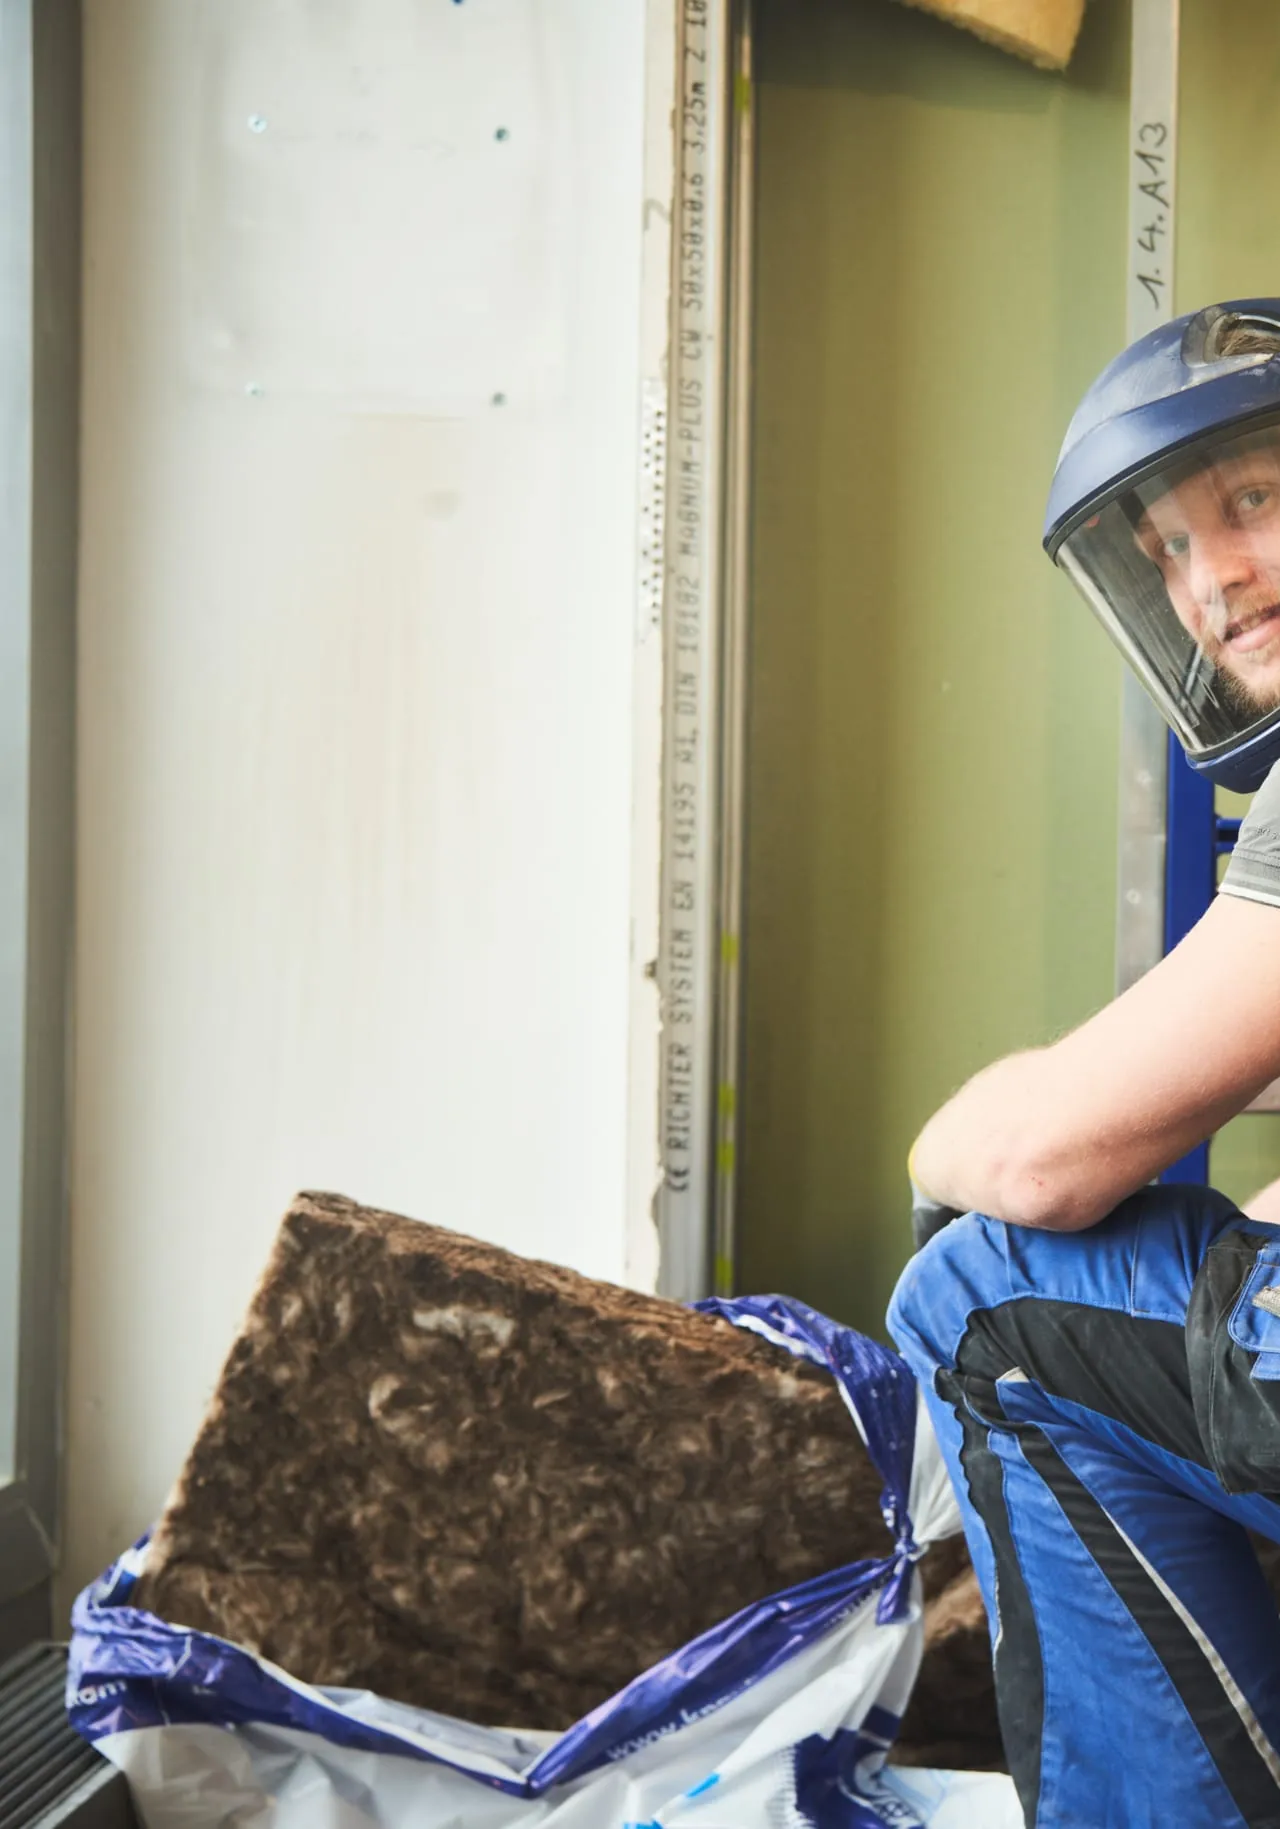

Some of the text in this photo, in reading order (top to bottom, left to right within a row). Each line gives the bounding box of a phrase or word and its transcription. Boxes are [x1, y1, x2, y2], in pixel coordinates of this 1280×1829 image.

[680, 330, 703, 360] CW
[677, 378, 702, 556] MAGNUM-PLUS
[675, 574, 700, 654] 18182
[674, 671, 698, 715] DIN
[671, 783, 696, 862] 14195
[669, 881, 695, 912] EN
[667, 928, 694, 1025] SYSTEM
[665, 1042, 692, 1150] RICHTER
